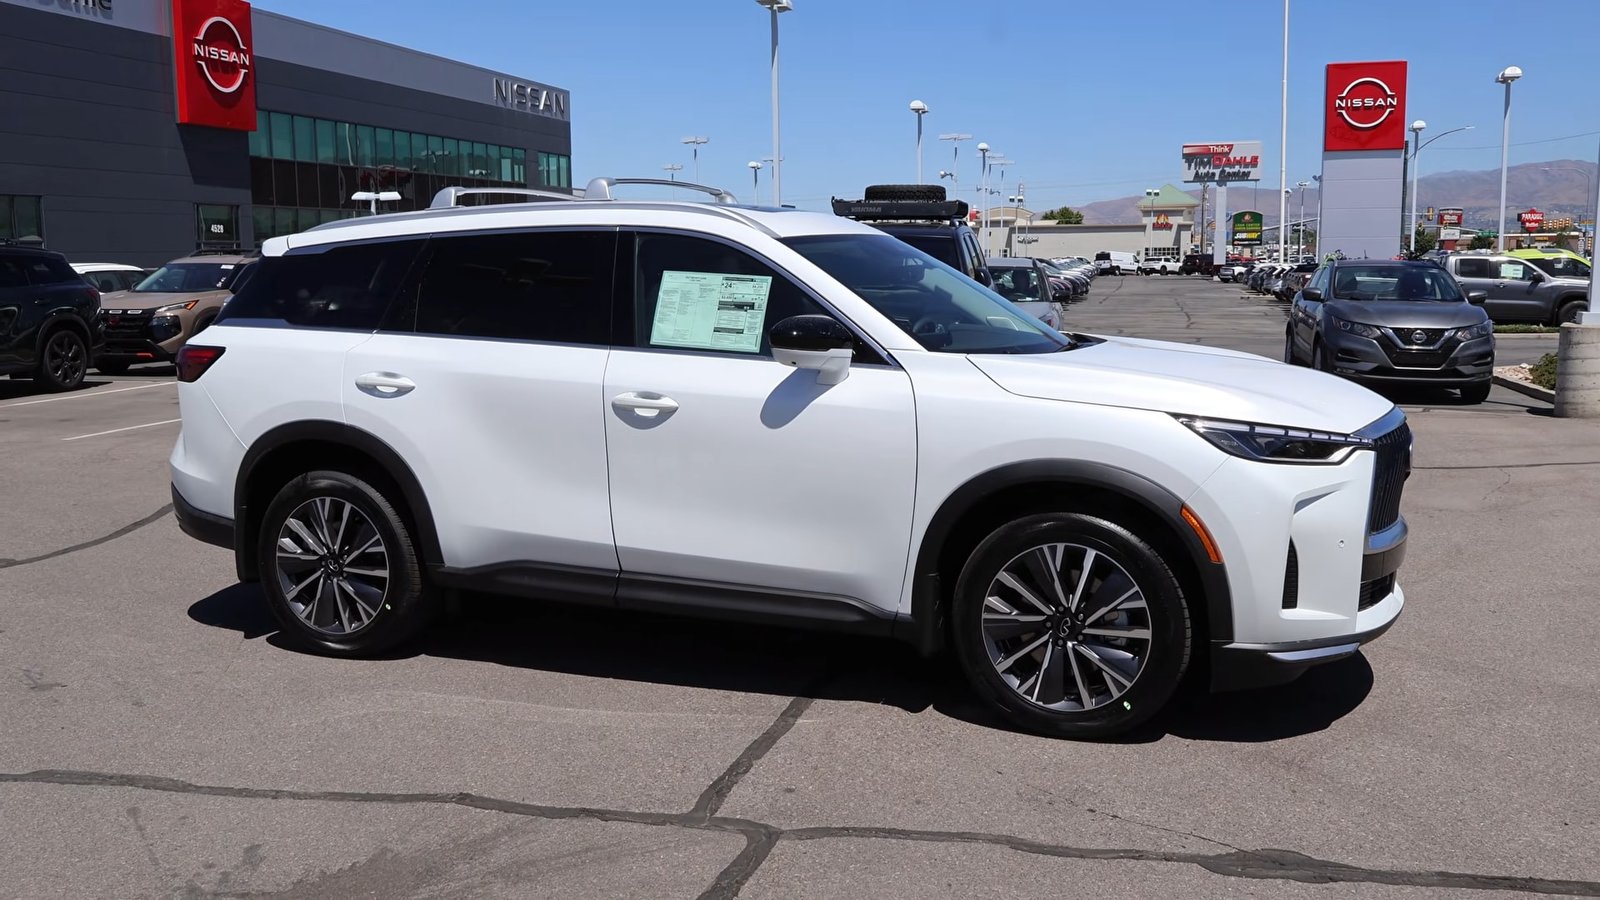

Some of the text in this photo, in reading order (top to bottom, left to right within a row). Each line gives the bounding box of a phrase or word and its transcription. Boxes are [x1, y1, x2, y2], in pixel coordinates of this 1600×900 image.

[193, 43, 250, 66] NISSAN
[493, 78, 565, 114] NISSAN
[1335, 97, 1398, 108] NISSAN
[1208, 145, 1230, 153] Think
